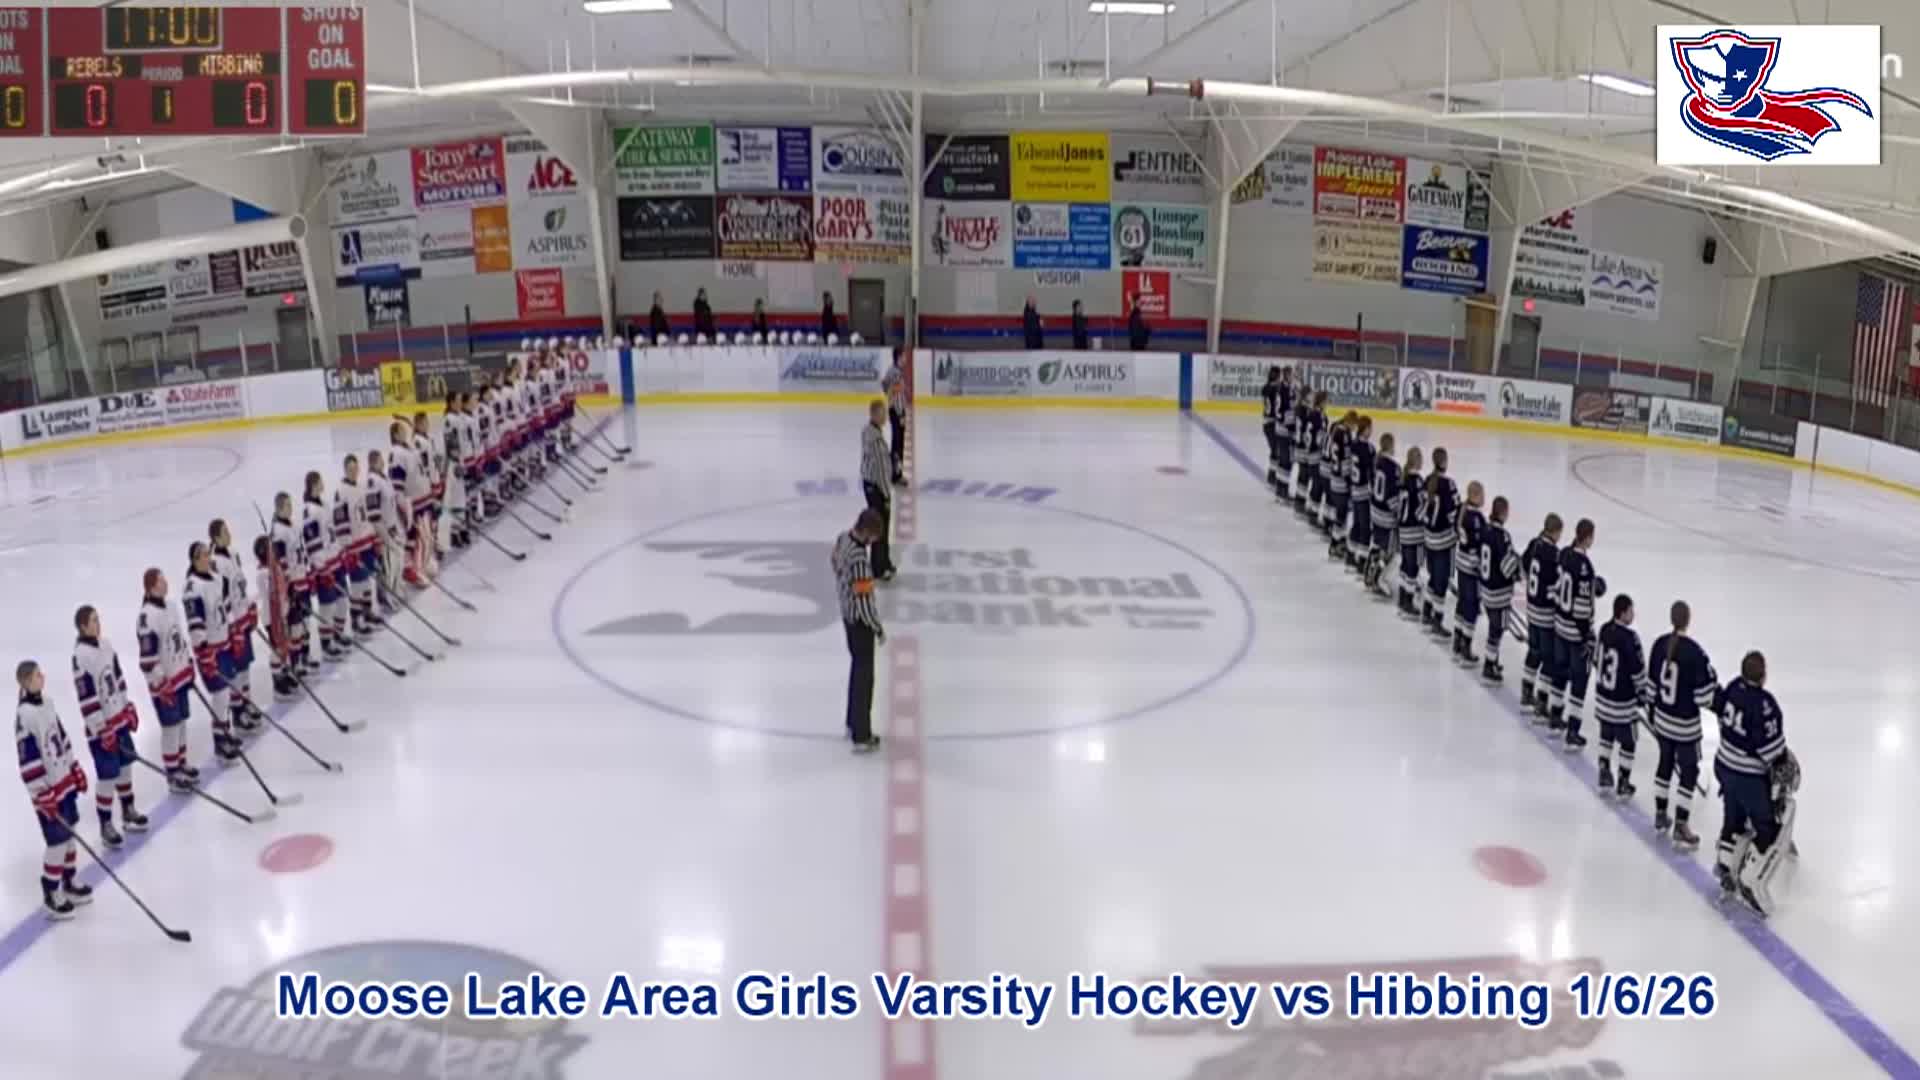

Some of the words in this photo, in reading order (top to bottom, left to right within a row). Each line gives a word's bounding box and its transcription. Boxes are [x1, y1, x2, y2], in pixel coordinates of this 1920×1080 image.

[318, 24, 344, 45] ON
[66, 56, 123, 78] REBELS
[308, 50, 354, 69] GOAL
[5, 86, 25, 128] 0
[86, 84, 108, 127] 0
[245, 81, 268, 125] 0
[333, 80, 357, 125] 0
[423, 148, 465, 168] Tony
[417, 164, 498, 187] Stewart
[527, 154, 578, 191] ACE
[1317, 161, 1403, 186] IMPLEMENT
[422, 184, 498, 202] MOTORS
[1408, 183, 1465, 209] GATEWAY
[821, 197, 867, 218] POOR
[1152, 208, 1199, 225] Lounge
[816, 220, 873, 239] GARY'S
[1122, 228, 1144, 244] 61
[527, 235, 587, 254] ASPIRUS
[1415, 229, 1478, 252] Beaver
[1037, 271, 1082, 285] VISITOR
[1063, 362, 1127, 380] ASPIRUS
[1311, 375, 1376, 396] LIQUOR
[40, 406, 89, 423] Lampert
[47, 421, 91, 436] Lumber
